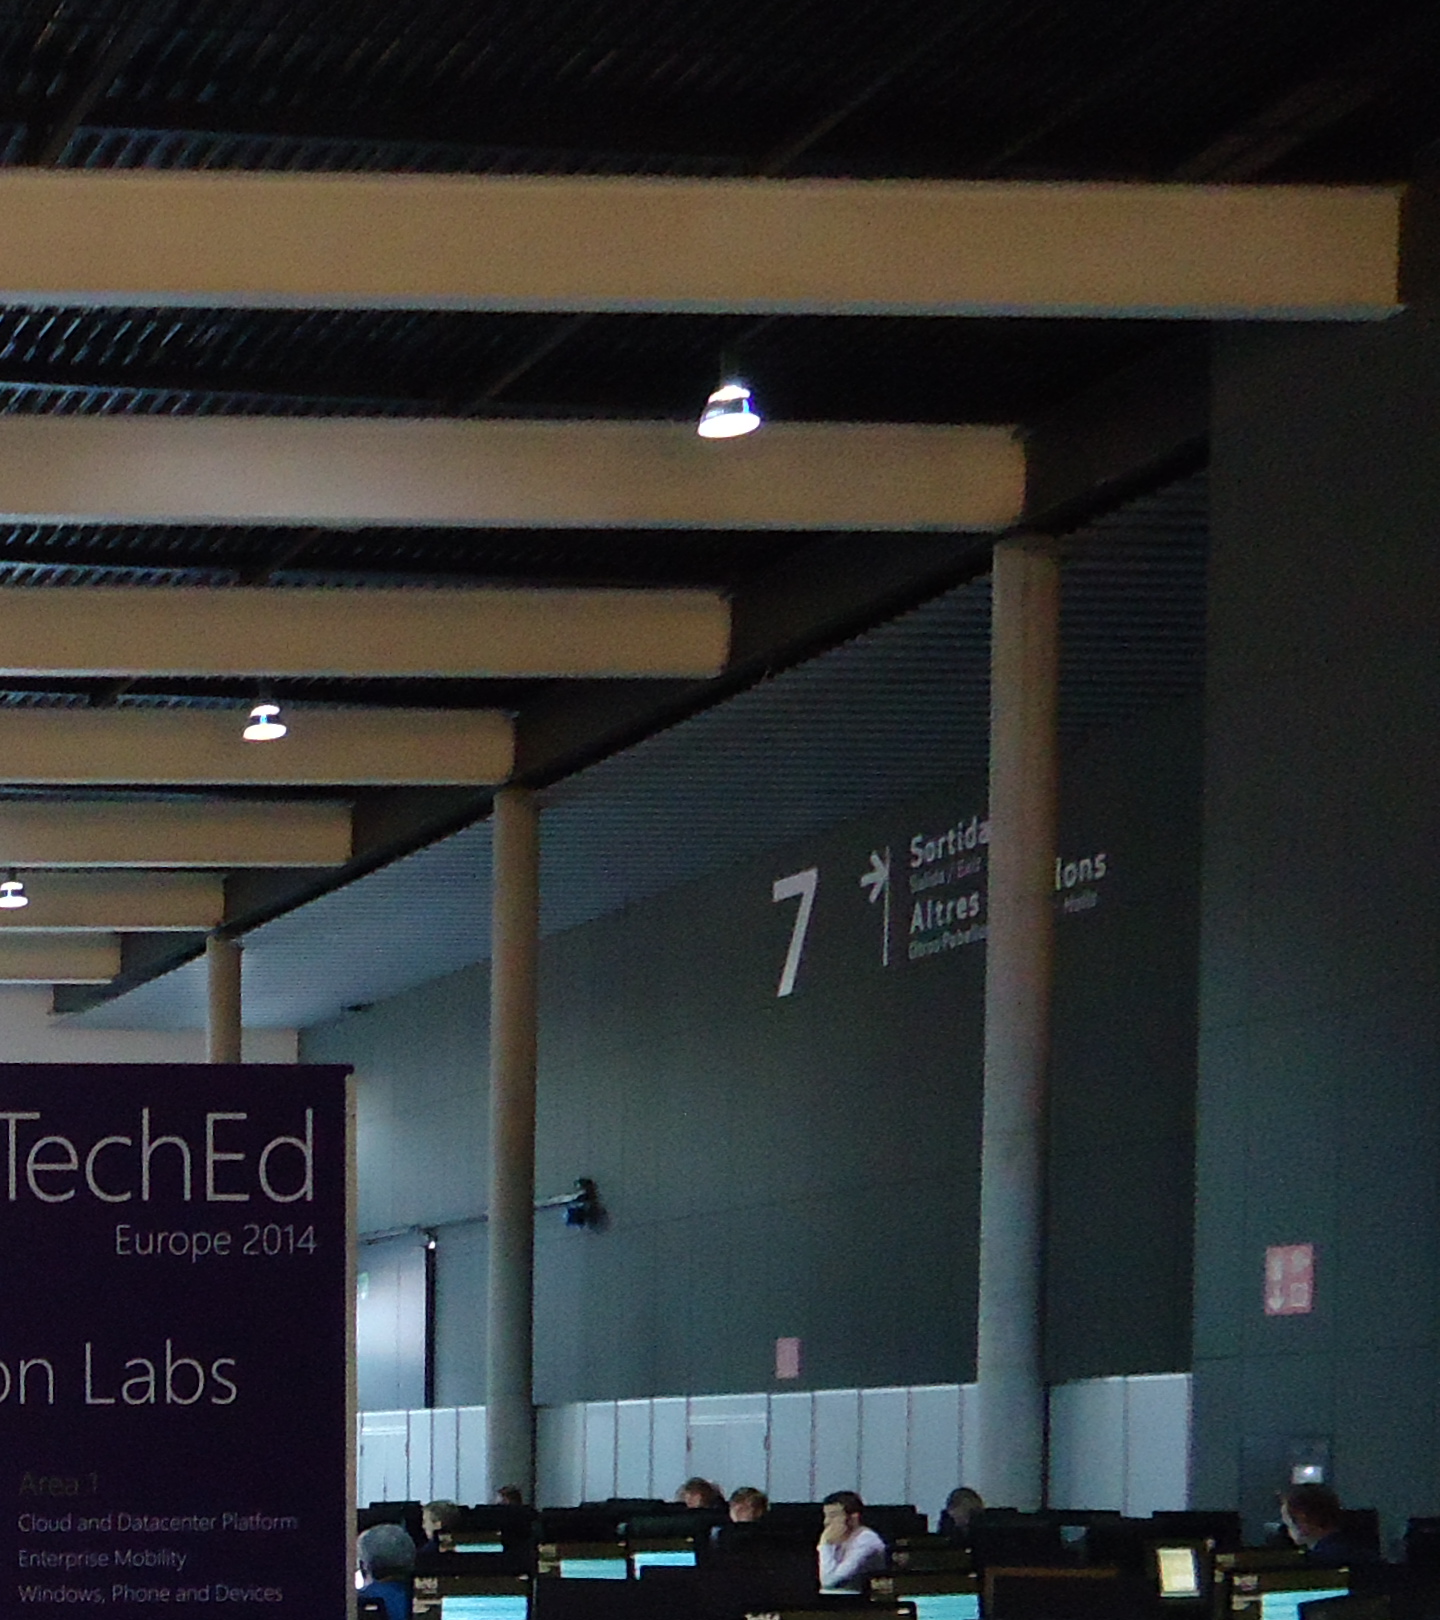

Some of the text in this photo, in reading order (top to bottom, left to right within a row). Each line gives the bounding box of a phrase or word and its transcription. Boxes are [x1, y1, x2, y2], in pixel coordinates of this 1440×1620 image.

[909, 815, 991, 868] Sortida
[909, 853, 1107, 934] Altres lons
[770, 866, 819, 999] 7
[116, 1224, 318, 1262] Europe 2014
[85, 1339, 238, 1406] Labs
[19, 1472, 80, 1497] Area
[17, 1512, 298, 1532] Cloud and Datacenter Platform
[18, 1548, 187, 1573] Enterprise Mobility
[18, 1583, 284, 1605] Windows, Phone and Devices
